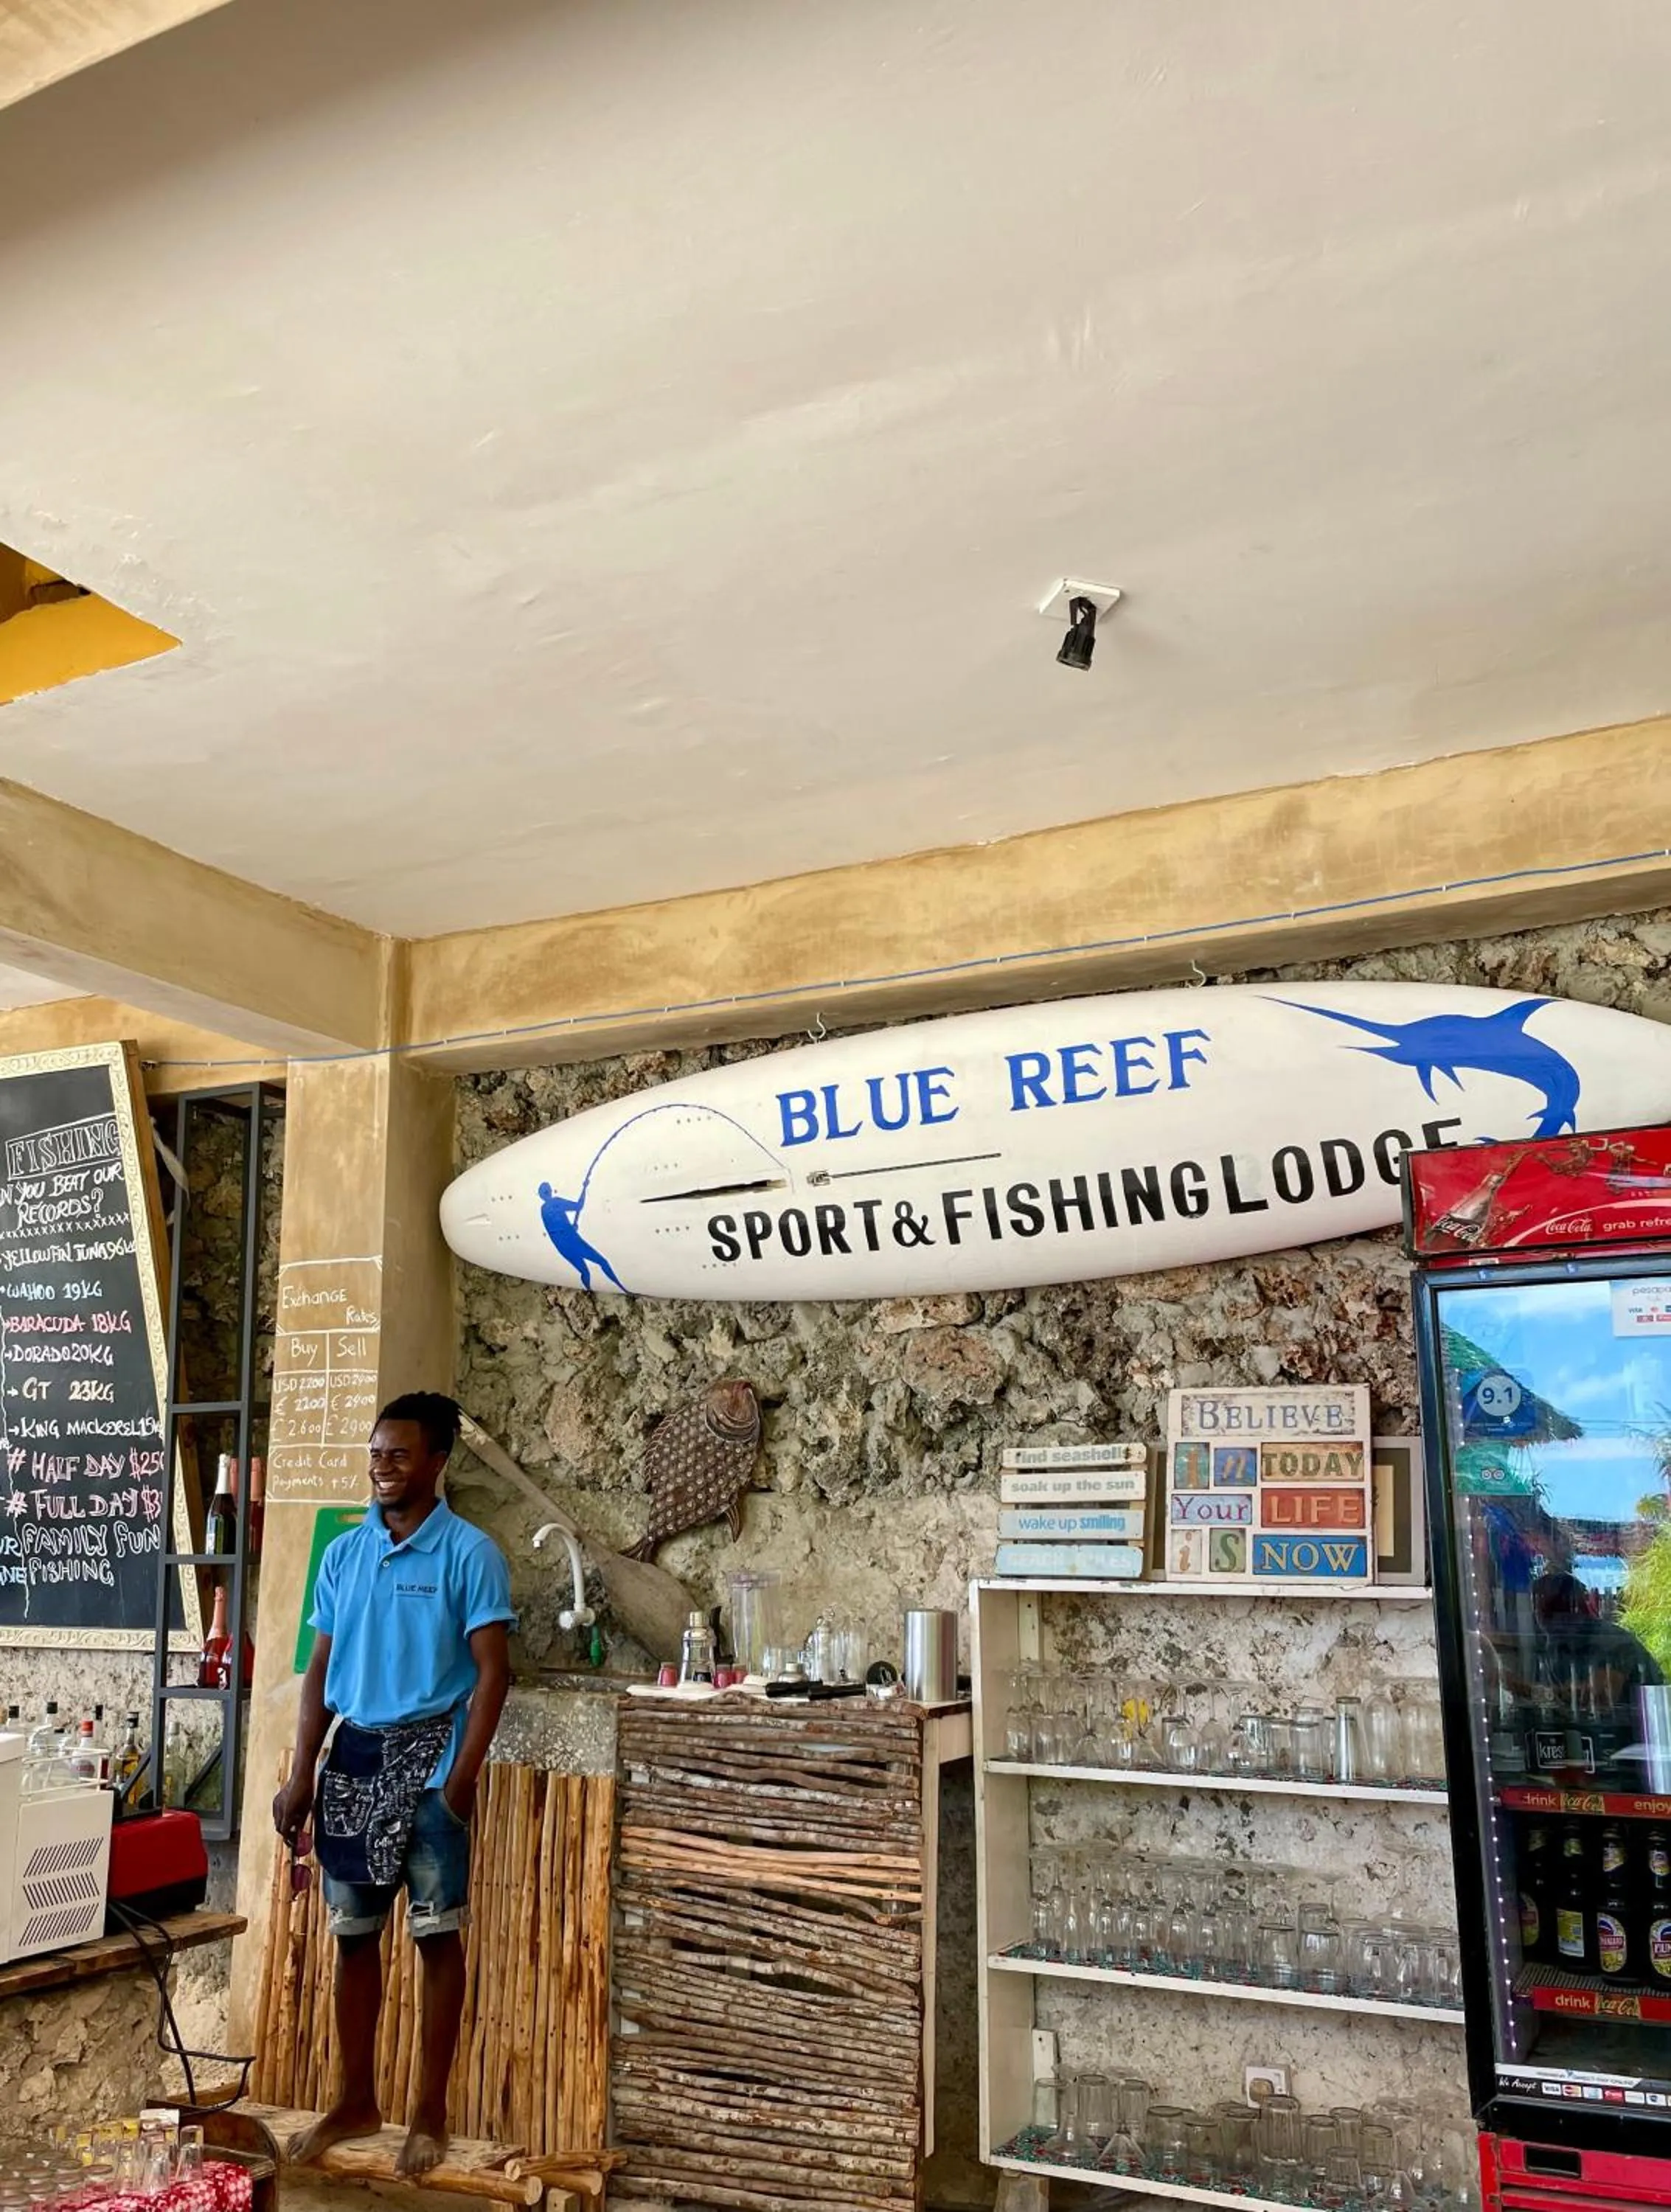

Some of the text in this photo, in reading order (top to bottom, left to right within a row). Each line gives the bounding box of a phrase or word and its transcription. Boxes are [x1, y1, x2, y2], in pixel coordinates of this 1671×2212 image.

[776, 1028, 1212, 1147] BLUE REEF
[9, 1119, 122, 1177] FISHING
[14, 1181, 46, 1205] YOU
[49, 1170, 91, 1197] BEAT
[94, 1162, 124, 1184] OUR
[16, 1188, 104, 1231] RECORDS?
[1602, 1220, 1636, 1232] grab
[7, 1280, 103, 1301] WAHOO 19KG
[91, 1309, 131, 1334] 18KG
[13, 1343, 114, 1366] DORADO 20KG
[291, 1335, 367, 1368] Buy Sell
[23, 1377, 114, 1403] GT 23KG
[273, 1378, 297, 1394] USD
[330, 1374, 352, 1388] USD
[1482, 1387, 1513, 1404] 9.1
[21, 1416, 60, 1439] KING
[32, 1450, 81, 1484] HALF
[83, 1453, 127, 1480] DAY
[273, 1451, 348, 1470] Credit Card
[1262, 1451, 1365, 1478] TODAY
[1011, 1479, 1136, 1494] soak up the sun
[29, 1489, 86, 1521] FULL
[88, 1488, 139, 1518] DAY
[141, 1484, 163, 1523] $3
[1173, 1495, 1360, 1524] Your LIFE
[1018, 1514, 1126, 1532] wake up smiling
[22, 1520, 161, 1558] FAMILY FUN
[1261, 1542, 1359, 1572] NOW
[29, 1557, 115, 1587] FISHING
[1555, 1994, 1591, 2010] drink
